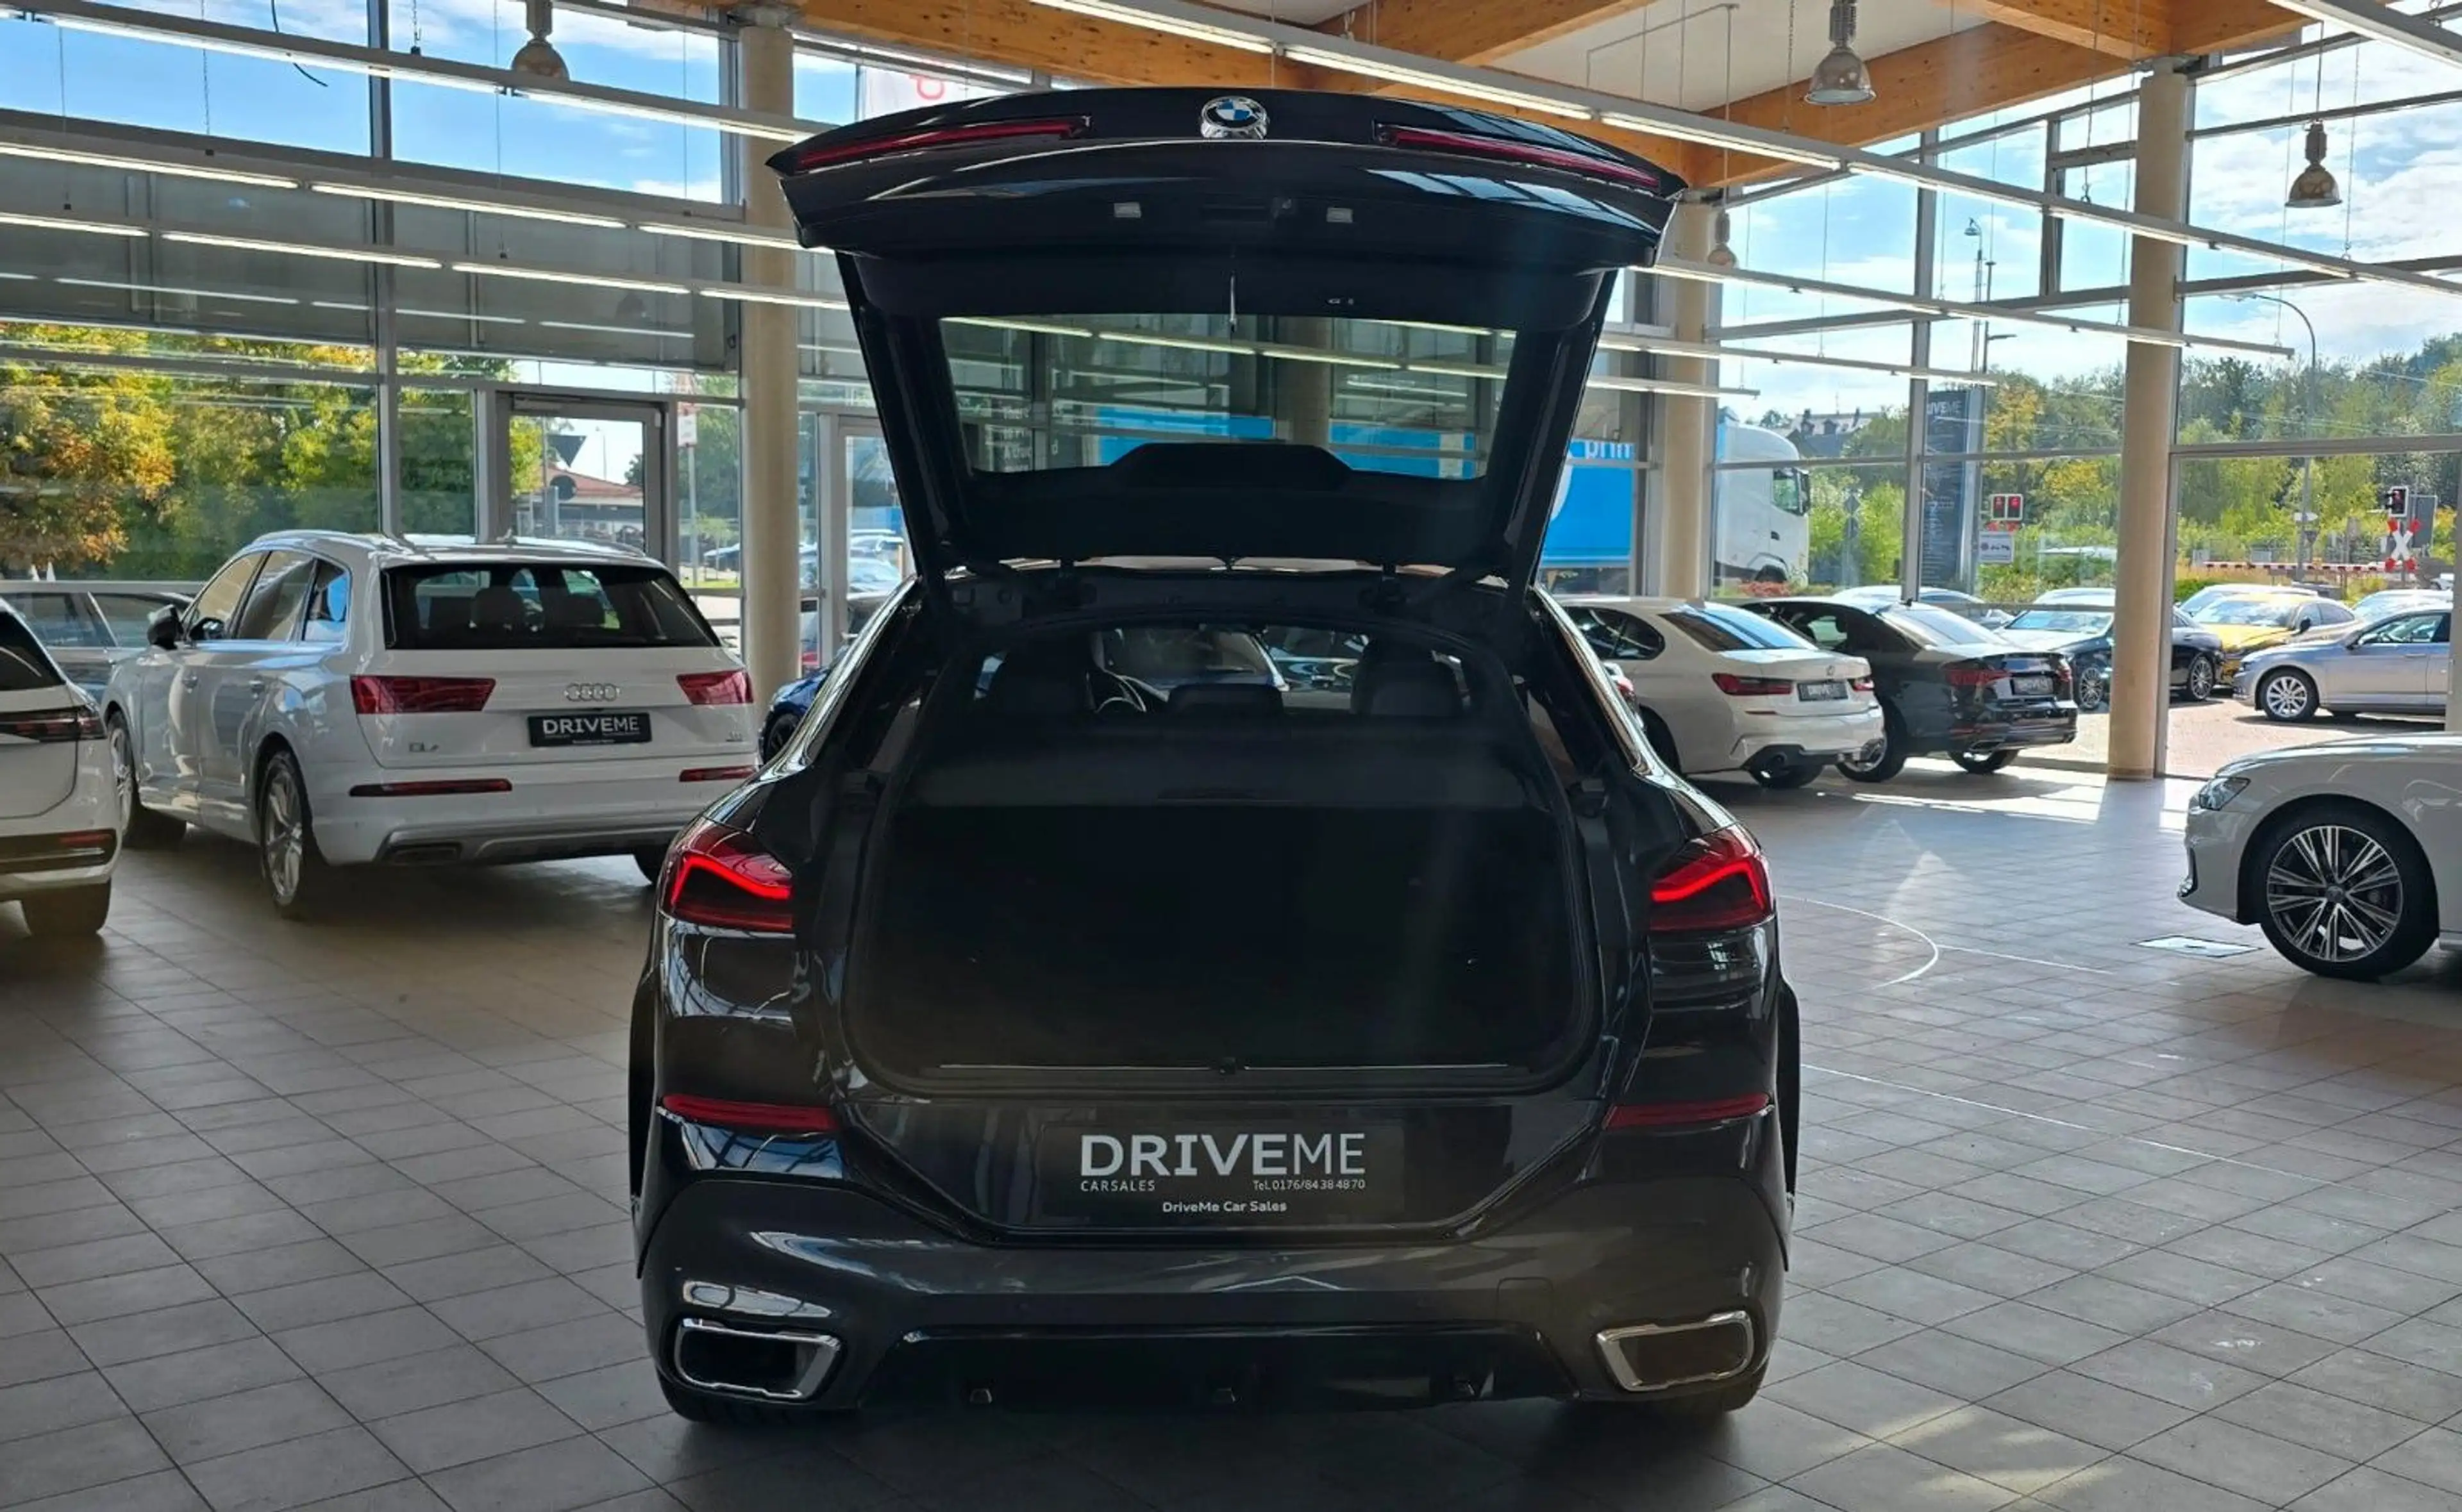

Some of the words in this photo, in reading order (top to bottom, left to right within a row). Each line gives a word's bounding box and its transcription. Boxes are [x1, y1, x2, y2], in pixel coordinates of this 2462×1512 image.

[542, 716, 640, 734] DRIVEME
[1081, 1133, 1366, 1176] DRIVEME
[1080, 1180, 1155, 1192] CARSALES
[1162, 1202, 1219, 1213] DriveMe
[1223, 1201, 1247, 1211] Car
[1250, 1200, 1287, 1212] Sales
